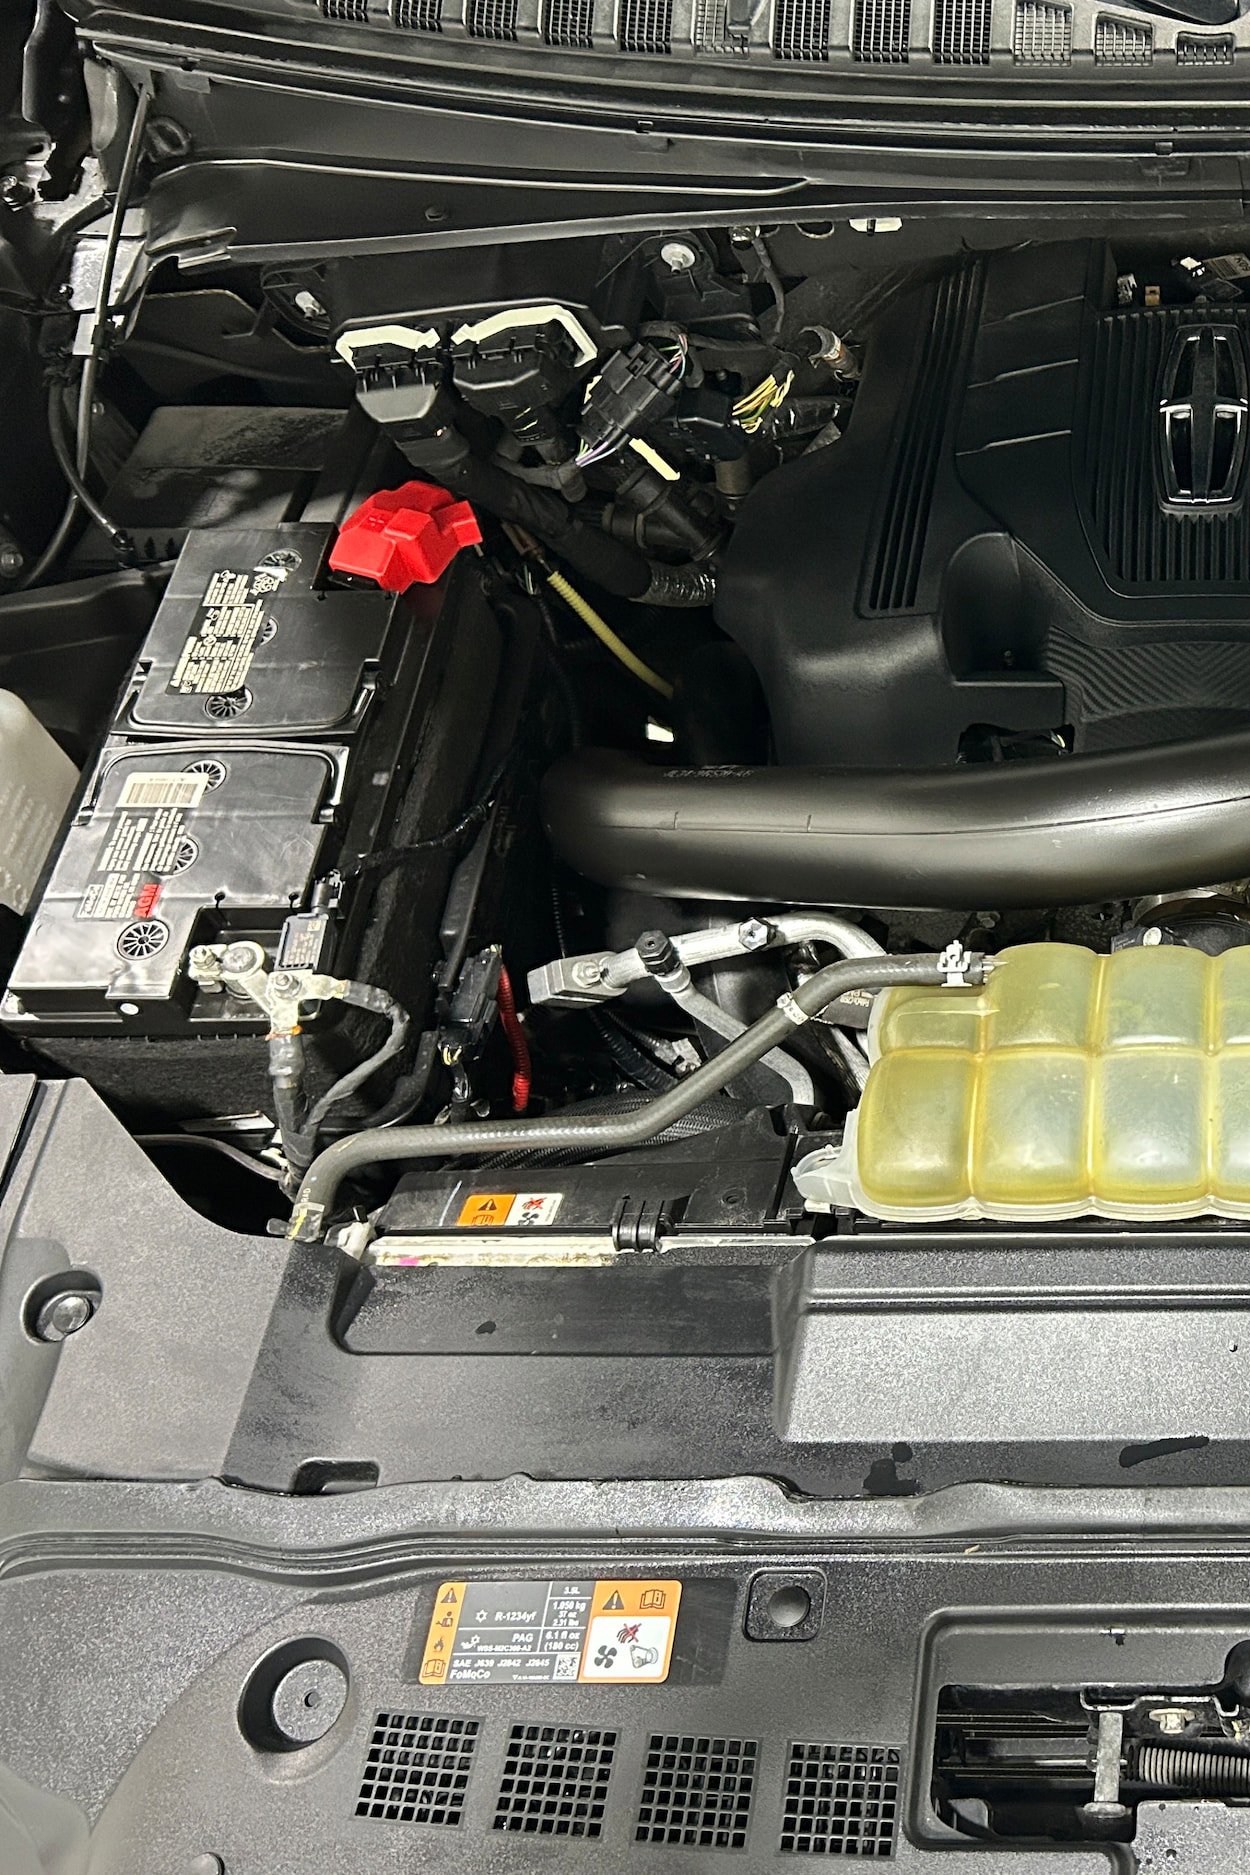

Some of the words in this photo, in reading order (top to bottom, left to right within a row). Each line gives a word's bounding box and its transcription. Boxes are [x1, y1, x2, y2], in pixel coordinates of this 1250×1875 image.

[134, 884, 159, 917] AGM
[552, 1601, 574, 1611] 1.050
[575, 1601, 587, 1612] kg
[494, 1611, 537, 1622] R-1234yf
[558, 1610, 568, 1618] 37
[552, 1619, 568, 1627] 2.31
[568, 1619, 579, 1627] lbs
[511, 1633, 534, 1643] PAG
[545, 1630, 559, 1640] 6.1
[560, 1630, 569, 1640] fl
[568, 1632, 580, 1640] oz
[544, 1641, 563, 1652] (180
[564, 1641, 579, 1652] cc)
[452, 1659, 472, 1667] SAE
[474, 1659, 495, 1668] J639
[449, 1669, 491, 1680] FoMoCo
